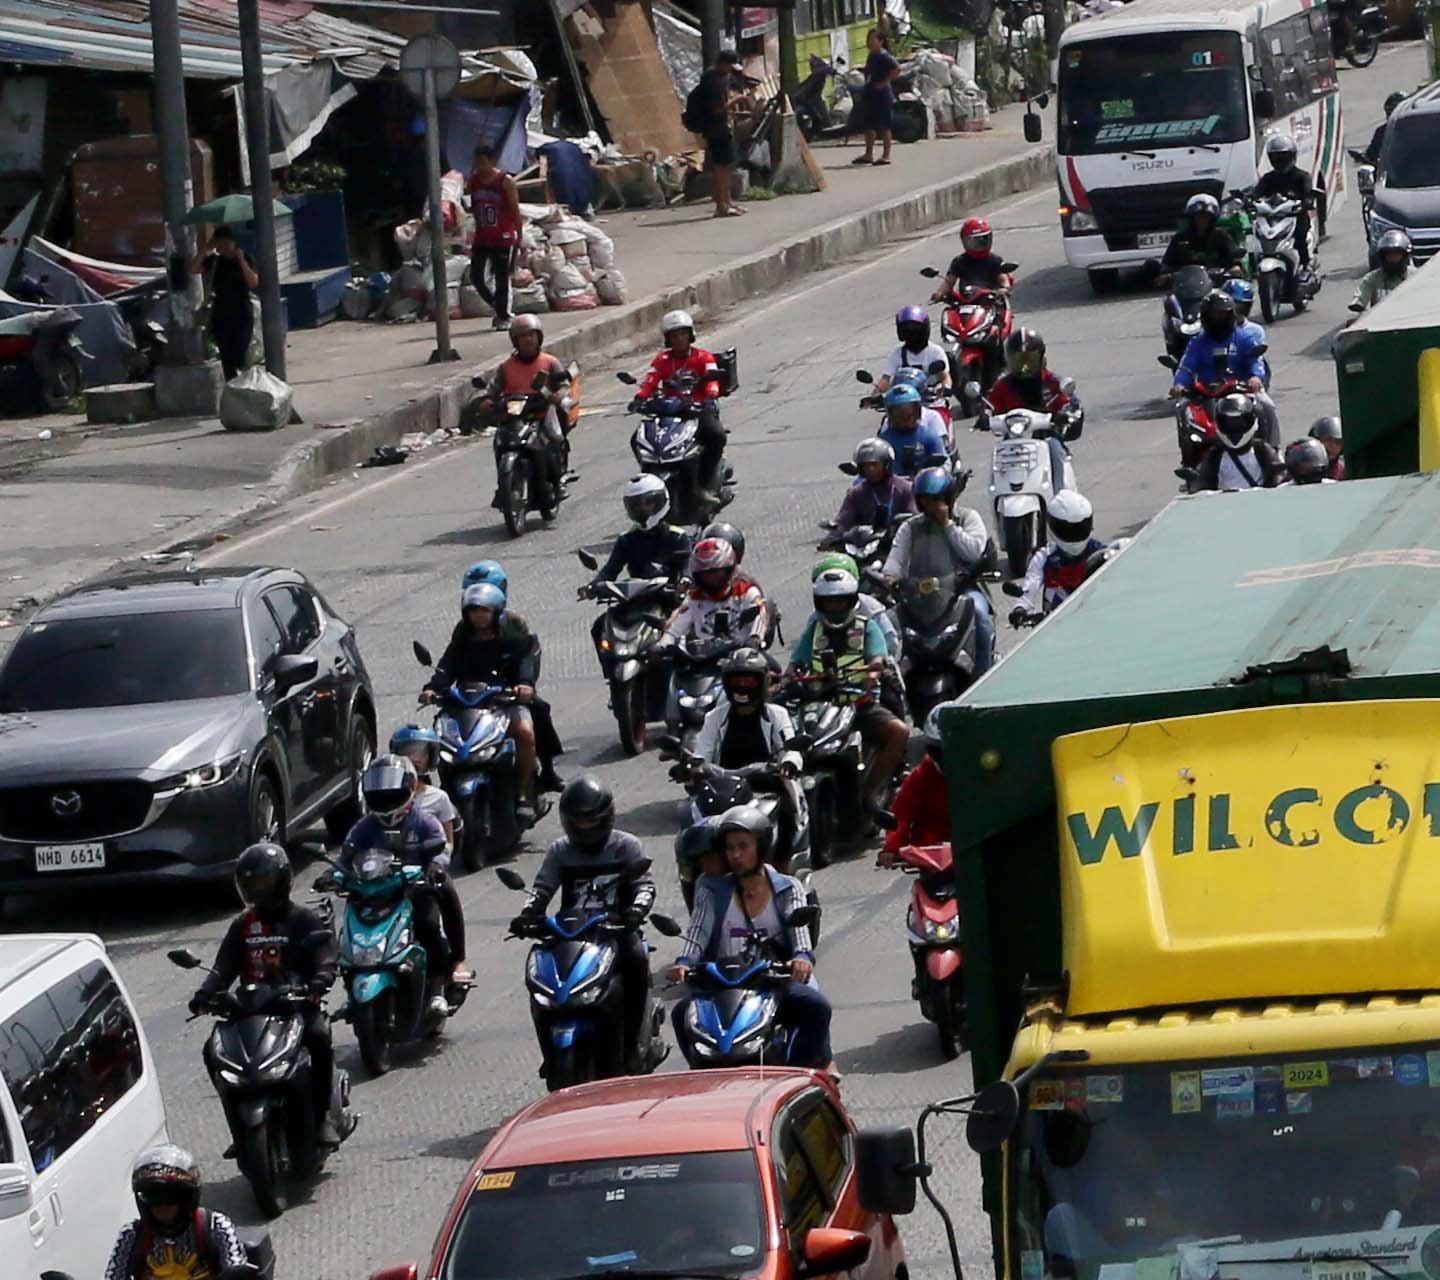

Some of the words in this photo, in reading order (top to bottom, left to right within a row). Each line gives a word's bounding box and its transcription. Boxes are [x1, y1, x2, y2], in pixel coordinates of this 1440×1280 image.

[1132, 159, 1174, 170] ISUZU
[38, 850, 62, 866] NHD
[71, 848, 103, 864] 6614
[1288, 1070, 1323, 1083] 2024
[1294, 1246, 1354, 1259] American
[1358, 1234, 1418, 1258] Standard
